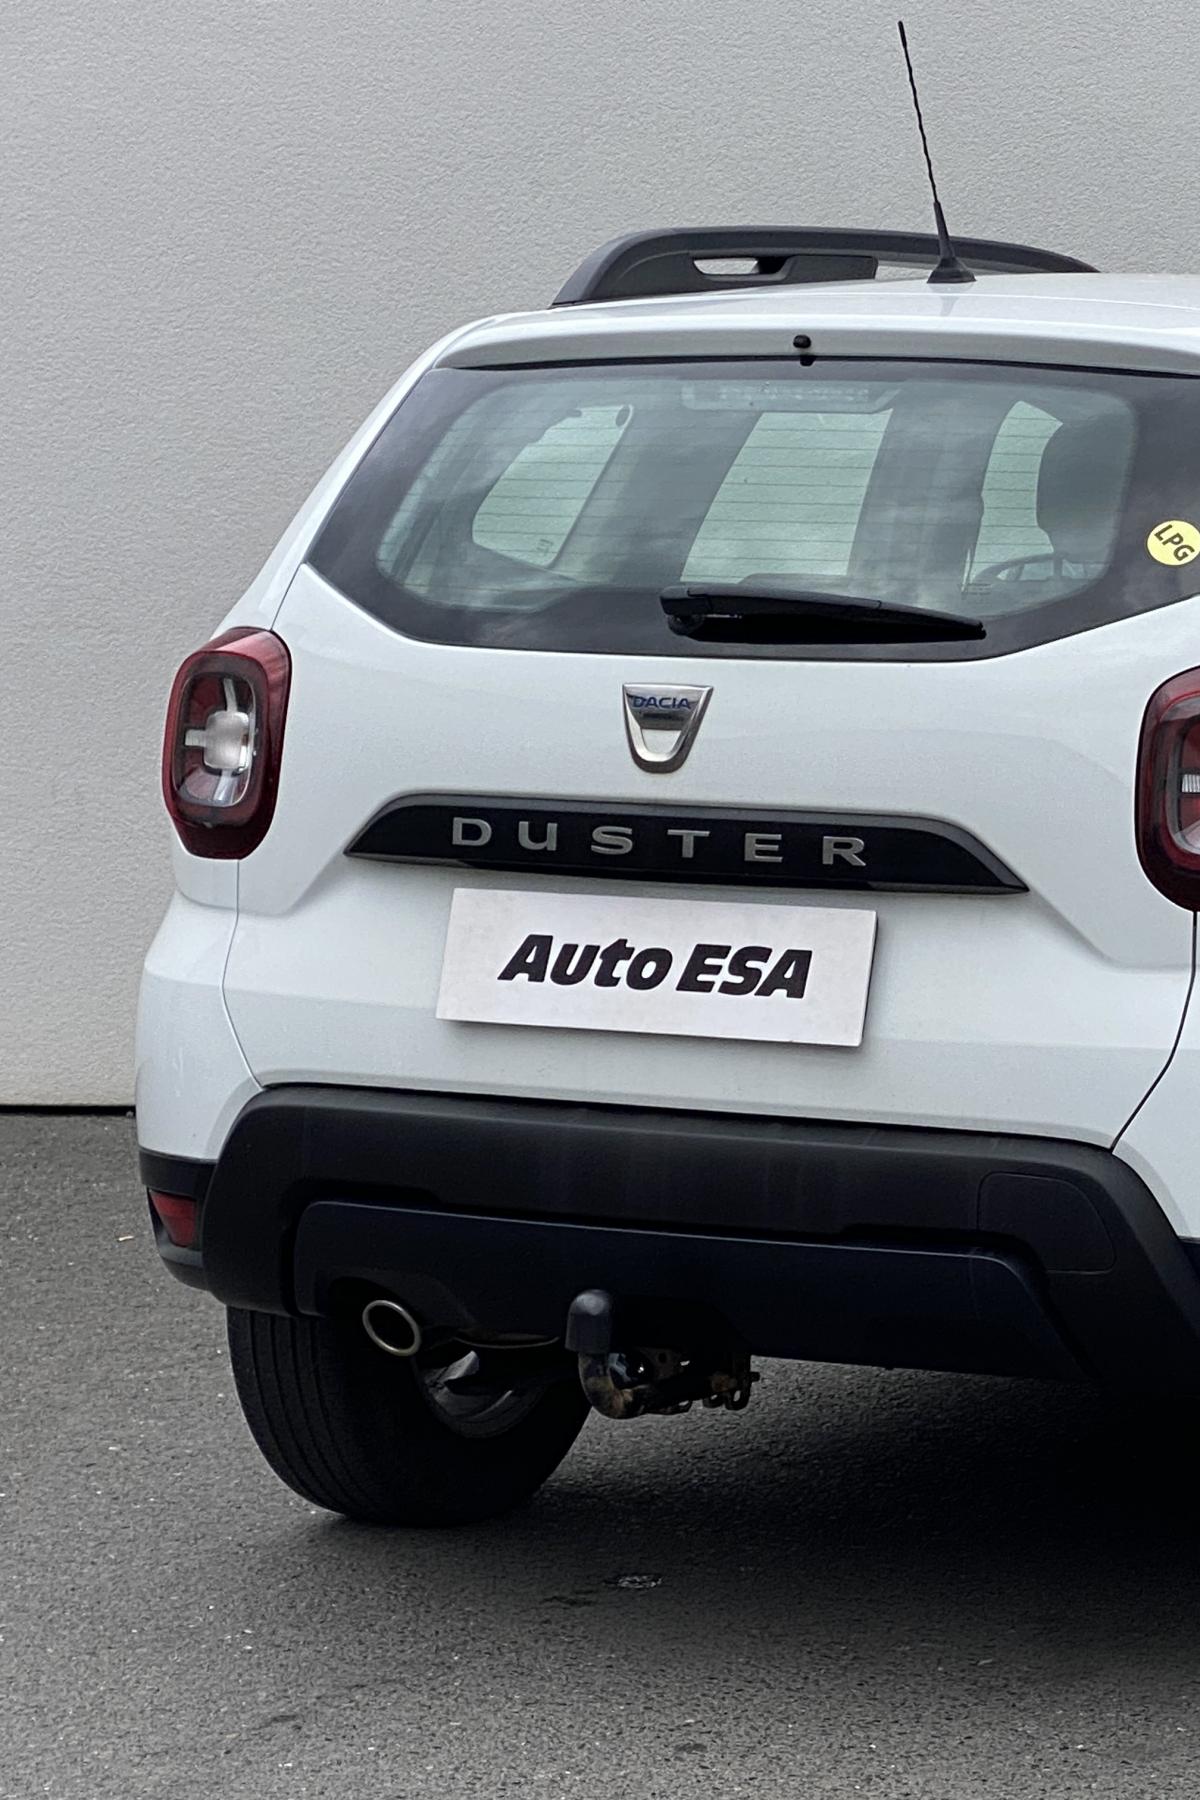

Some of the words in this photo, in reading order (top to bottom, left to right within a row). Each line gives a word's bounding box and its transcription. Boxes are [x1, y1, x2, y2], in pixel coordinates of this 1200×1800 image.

[1154, 524, 1195, 561] LPG
[633, 696, 691, 709] DACIA
[452, 817, 866, 866] DUSTER
[497, 934, 673, 990] Auto
[675, 943, 813, 999] ESA
